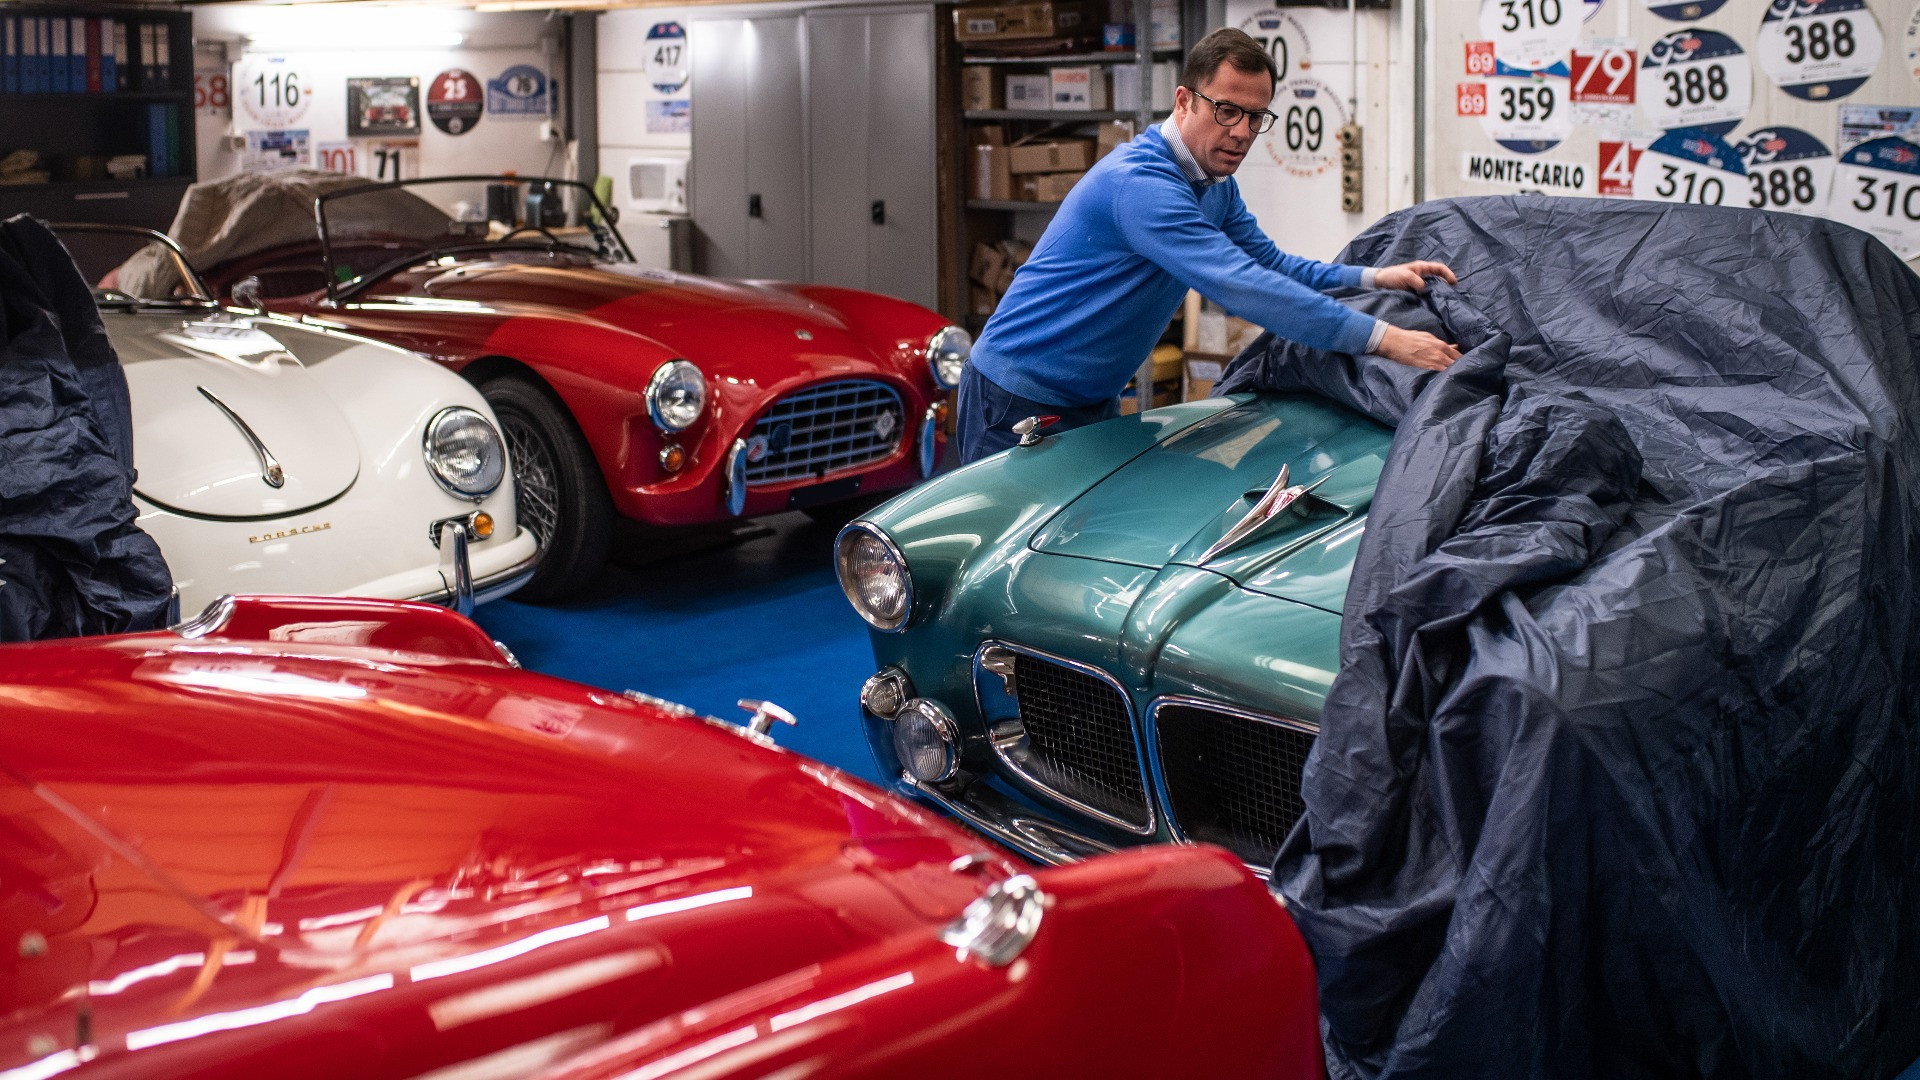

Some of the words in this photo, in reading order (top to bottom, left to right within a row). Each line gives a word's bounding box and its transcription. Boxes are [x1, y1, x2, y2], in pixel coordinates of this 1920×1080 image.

[1500, 0, 1561, 31] 310
[655, 45, 681, 66] 417
[1785, 18, 1856, 63] 388
[1468, 52, 1495, 73] 69
[1574, 48, 1633, 95] 79
[254, 72, 299, 107] 116
[1663, 64, 1728, 107] 388
[1459, 94, 1486, 114] 69
[1500, 86, 1555, 122] 359
[1286, 105, 1324, 152] 69
[374, 149, 401, 181] 71
[1468, 156, 1585, 189] MONTE-CARLO
[1657, 163, 1725, 206] 310
[1749, 165, 1816, 208] 388
[1853, 175, 1920, 221] 310
